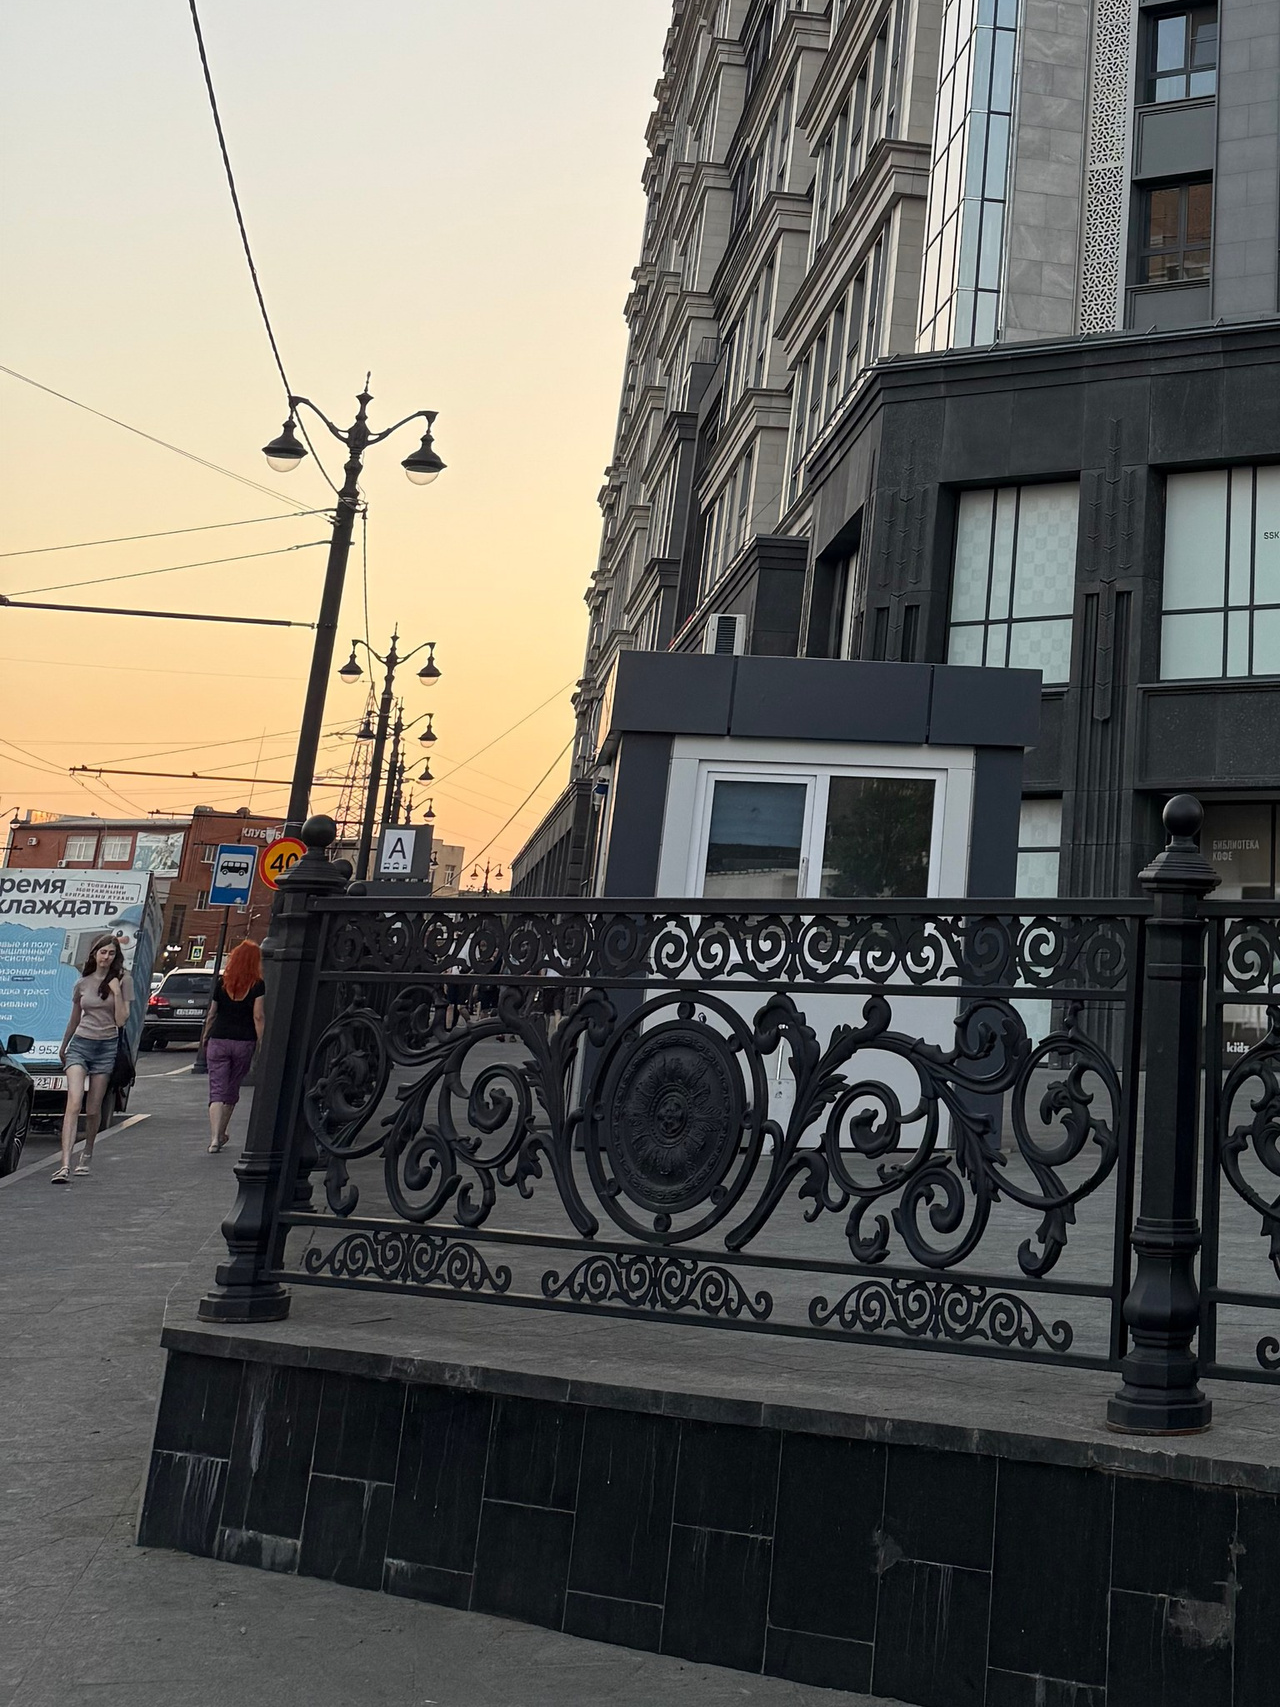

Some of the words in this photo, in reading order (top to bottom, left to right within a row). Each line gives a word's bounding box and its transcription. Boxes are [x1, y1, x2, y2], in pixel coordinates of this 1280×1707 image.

[241, 827, 267, 839] КЛУБ
[1212, 839, 1260, 850] БИБЛИОТЕКА
[1212, 851, 1233, 861] КОФЕ
[39, 1045, 59, 1055] 952
